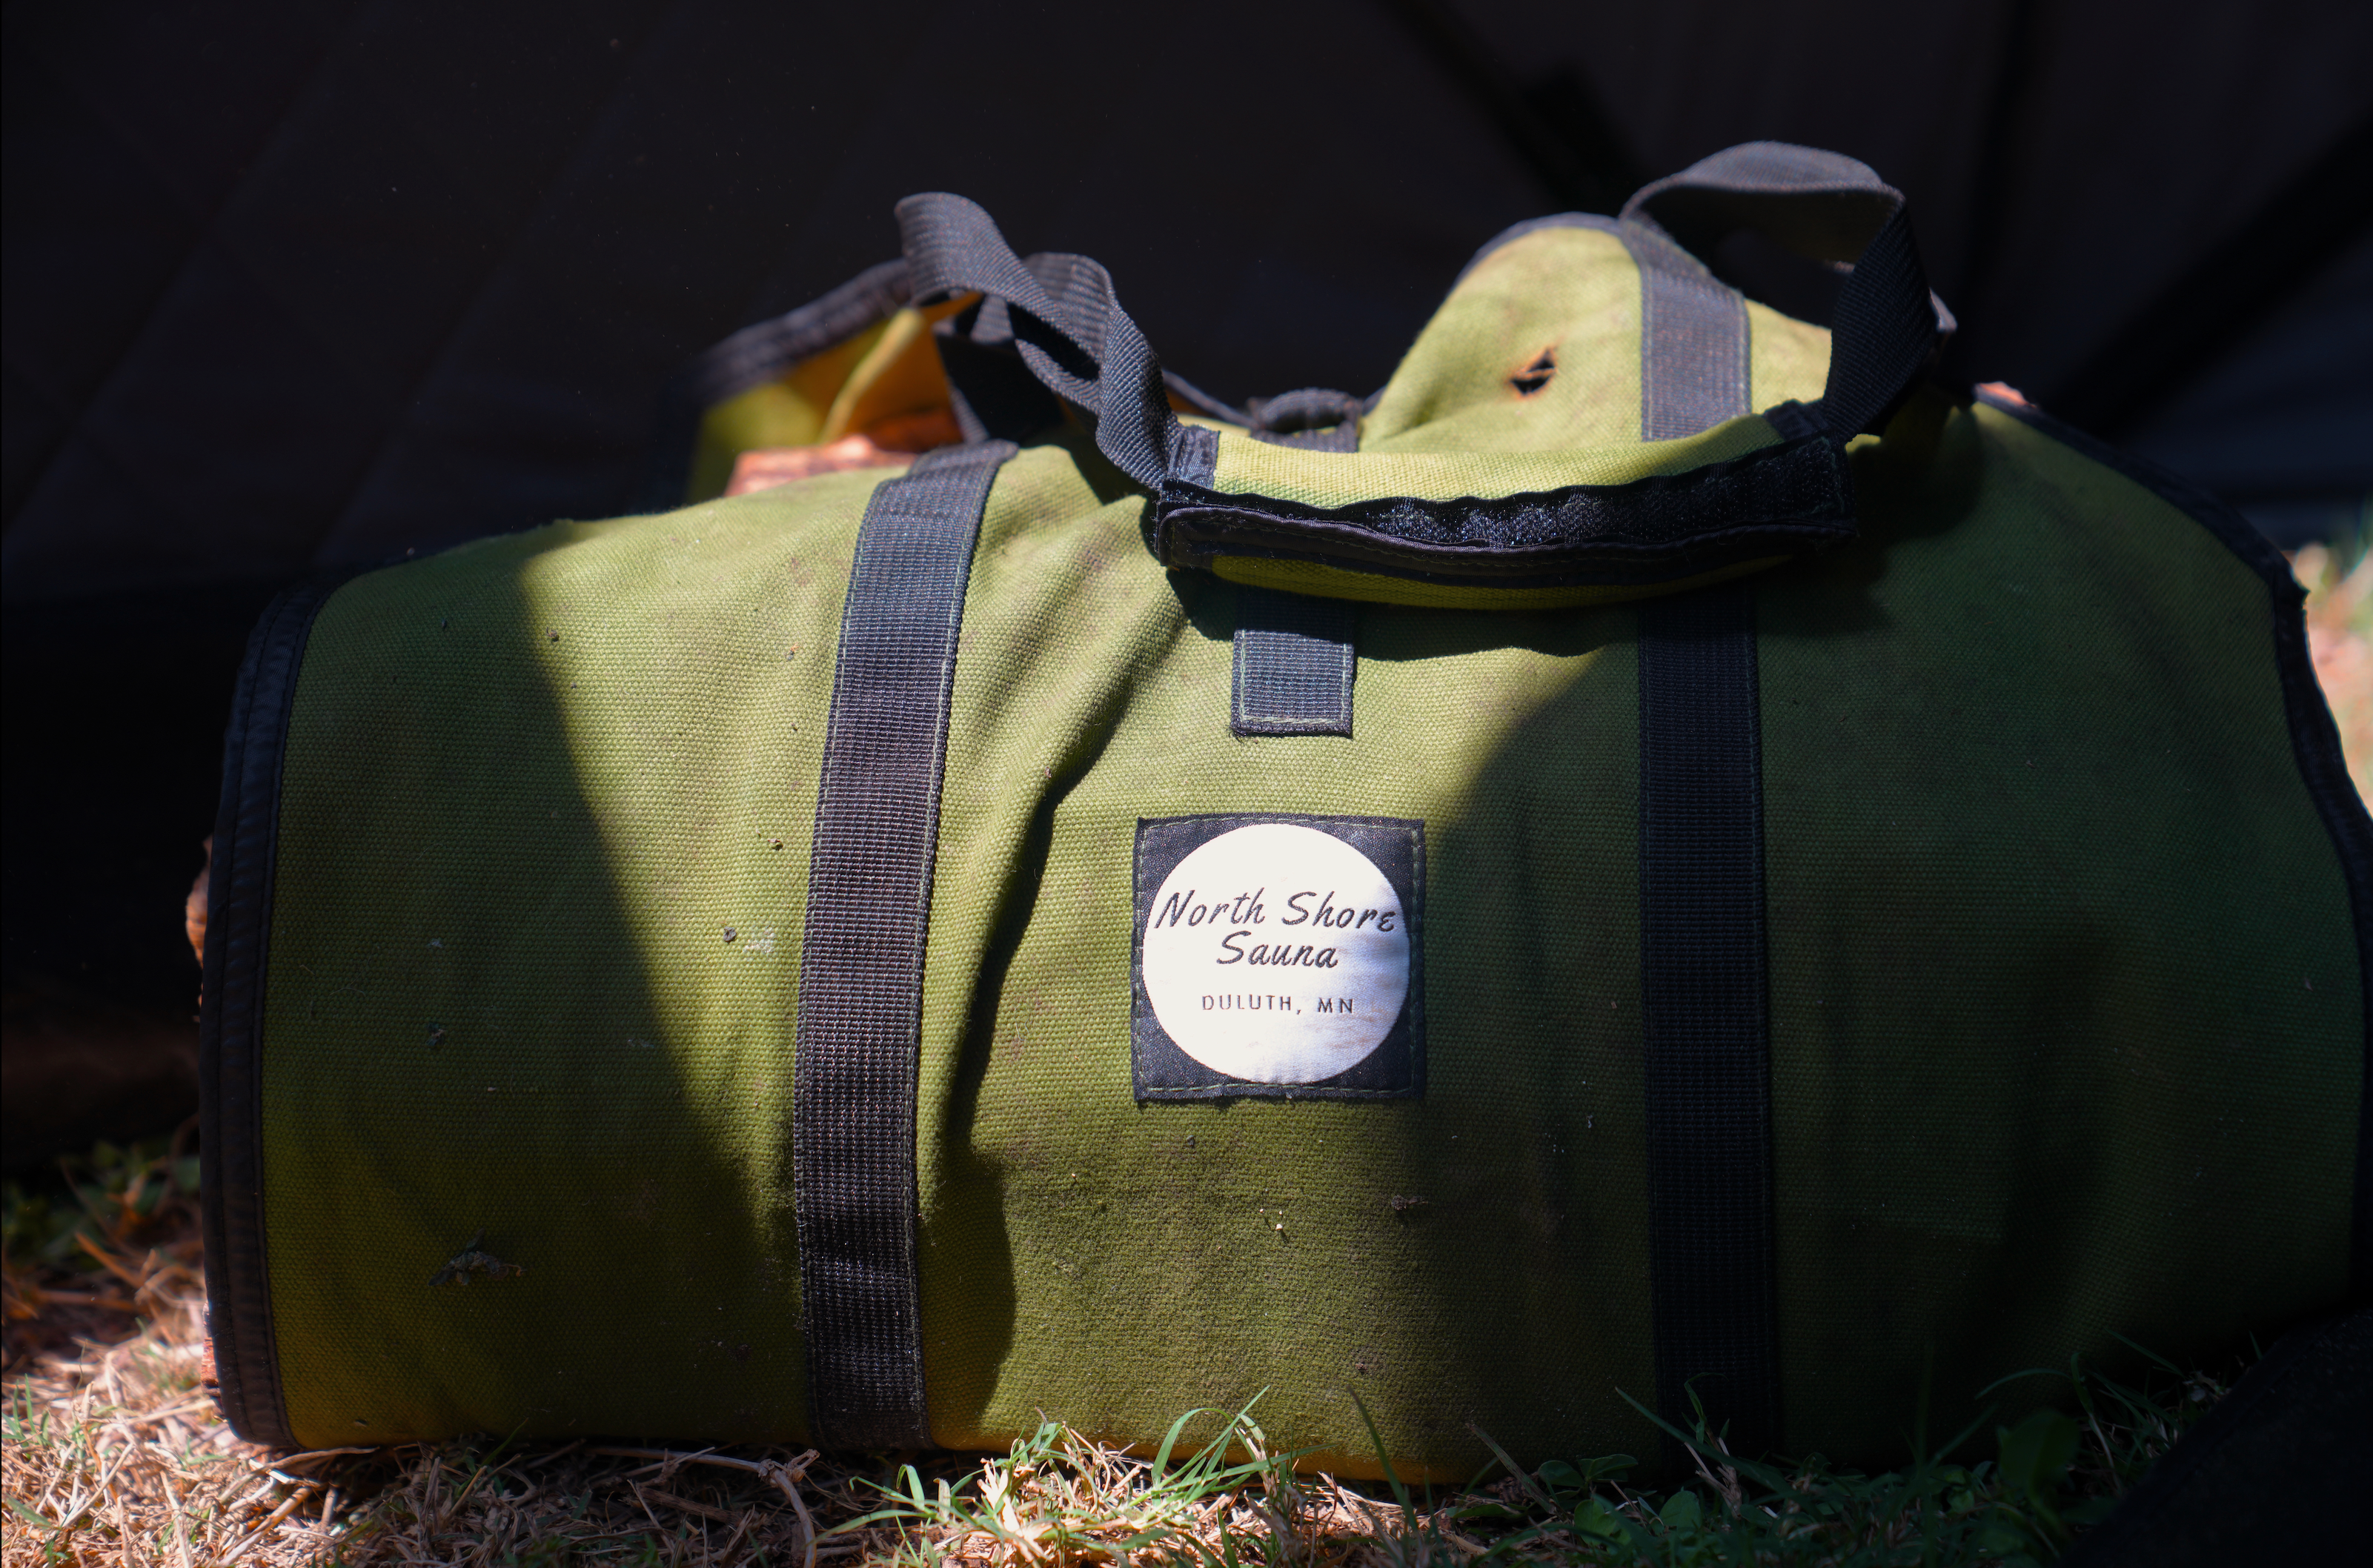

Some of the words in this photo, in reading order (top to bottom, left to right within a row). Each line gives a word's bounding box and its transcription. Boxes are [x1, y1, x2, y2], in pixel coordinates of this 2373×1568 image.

[1153, 887, 1266, 929] North
[1281, 891, 1397, 932] Shore
[1216, 931, 1338, 969] Sauna
[1201, 994, 1301, 1015] DULUTH,
[1317, 997, 1354, 1014] MN
